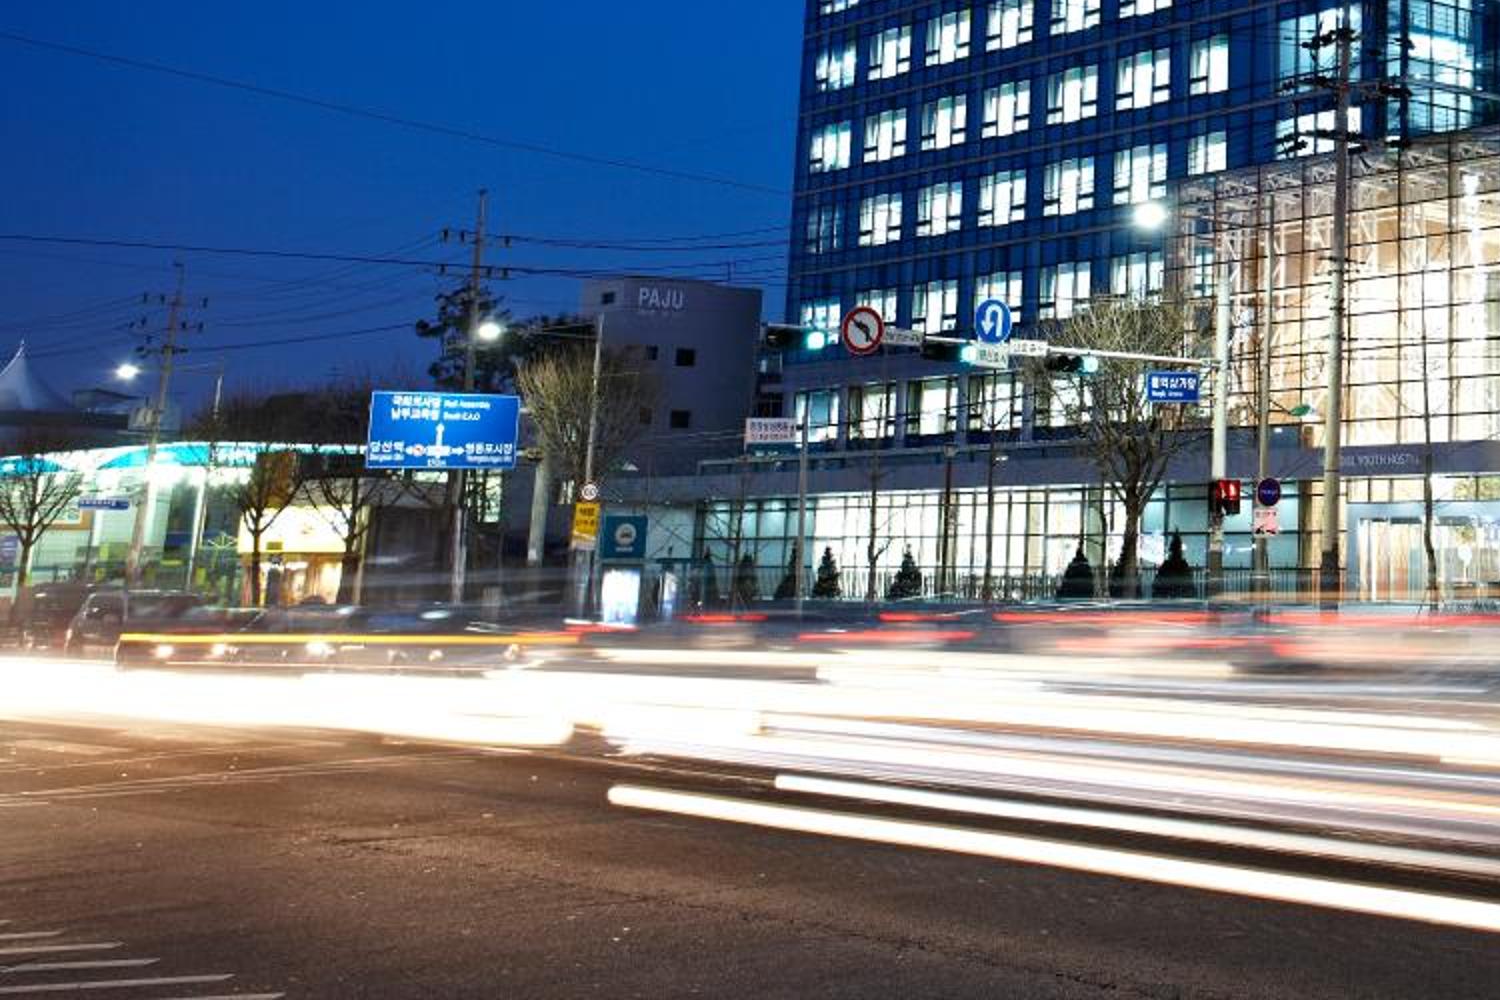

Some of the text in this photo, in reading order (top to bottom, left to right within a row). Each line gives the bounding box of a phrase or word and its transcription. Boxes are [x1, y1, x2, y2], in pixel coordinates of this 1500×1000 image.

[639, 287, 684, 310] PAJU
[369, 441, 404, 453] 당산역
[465, 442, 513, 455] 영등포시장
